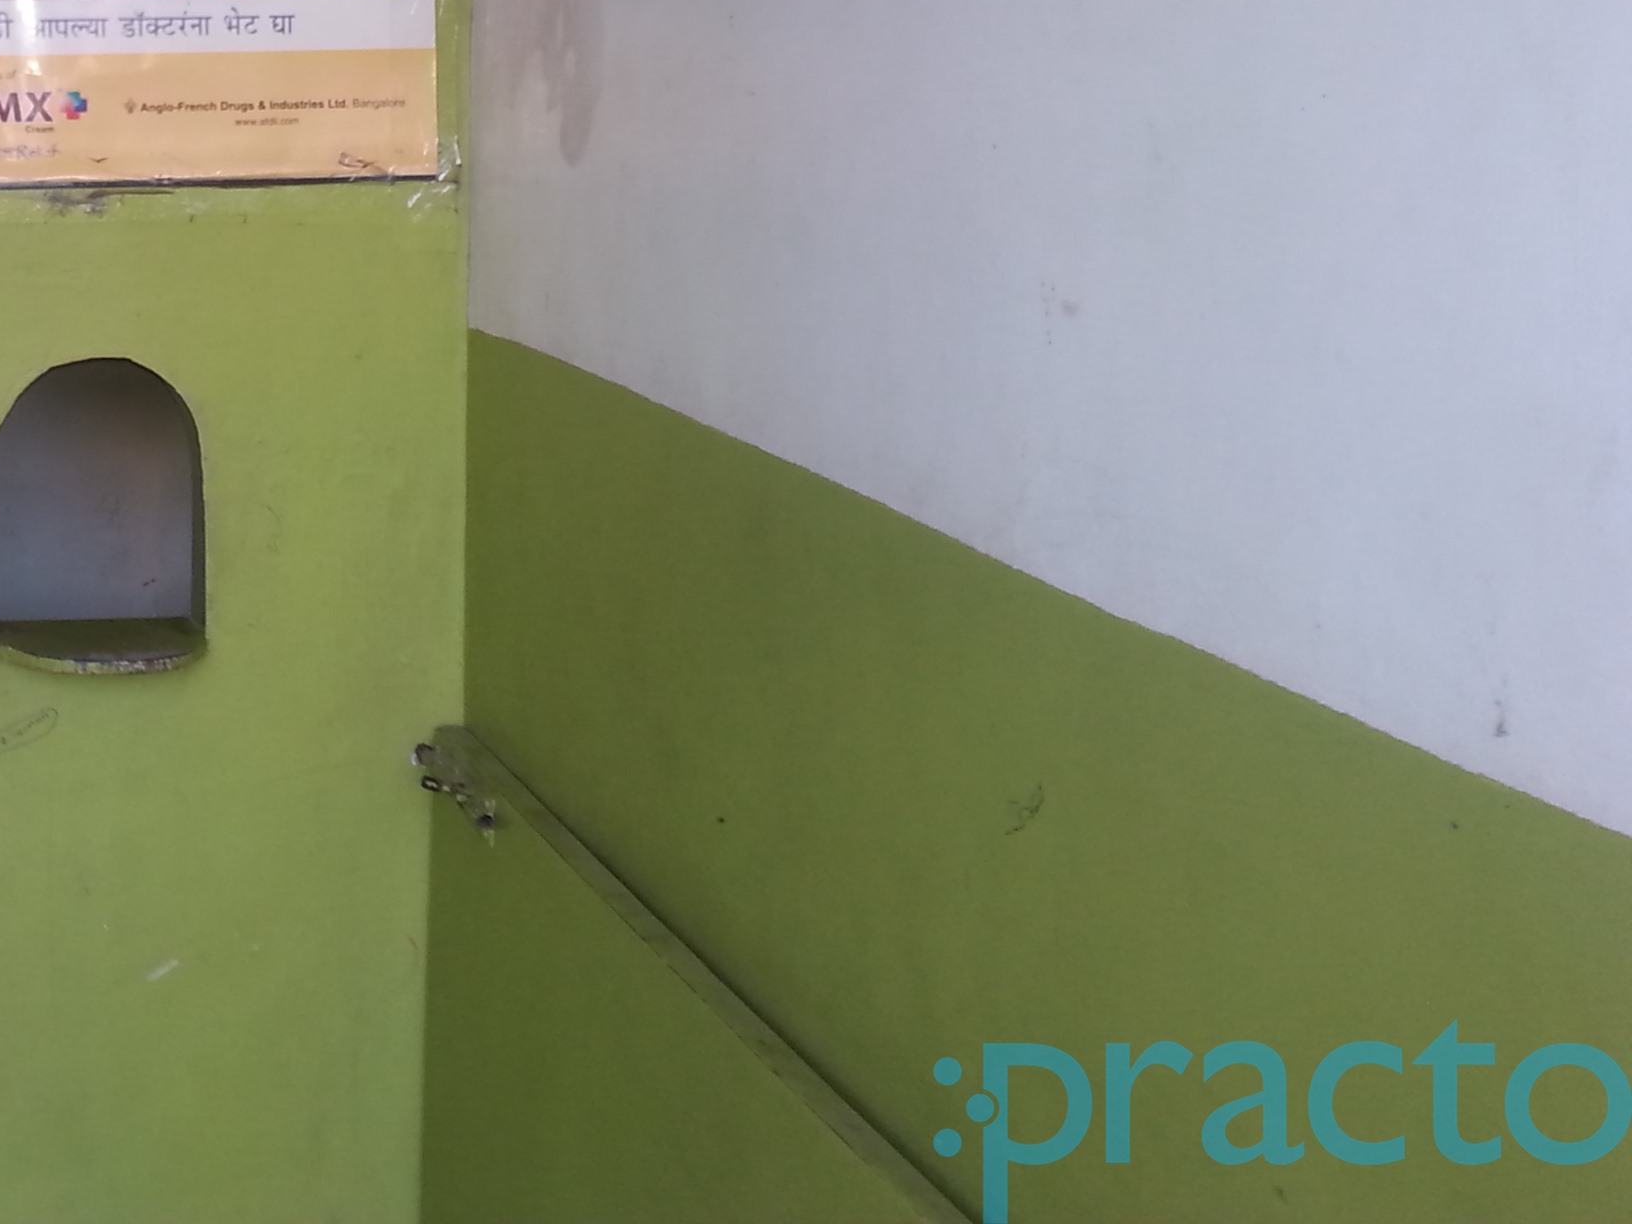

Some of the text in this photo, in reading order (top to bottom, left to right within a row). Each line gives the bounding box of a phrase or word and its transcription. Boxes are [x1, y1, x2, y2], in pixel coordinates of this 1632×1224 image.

[223, 7, 260, 36] भेट
[5, 68, 18, 81] of
[140, 100, 217, 115] Anglo-French
[219, 100, 255, 114] Drugs
[257, 100, 266, 111] &
[269, 98, 324, 111] Industries
[327, 97, 349, 110] Ltd.
